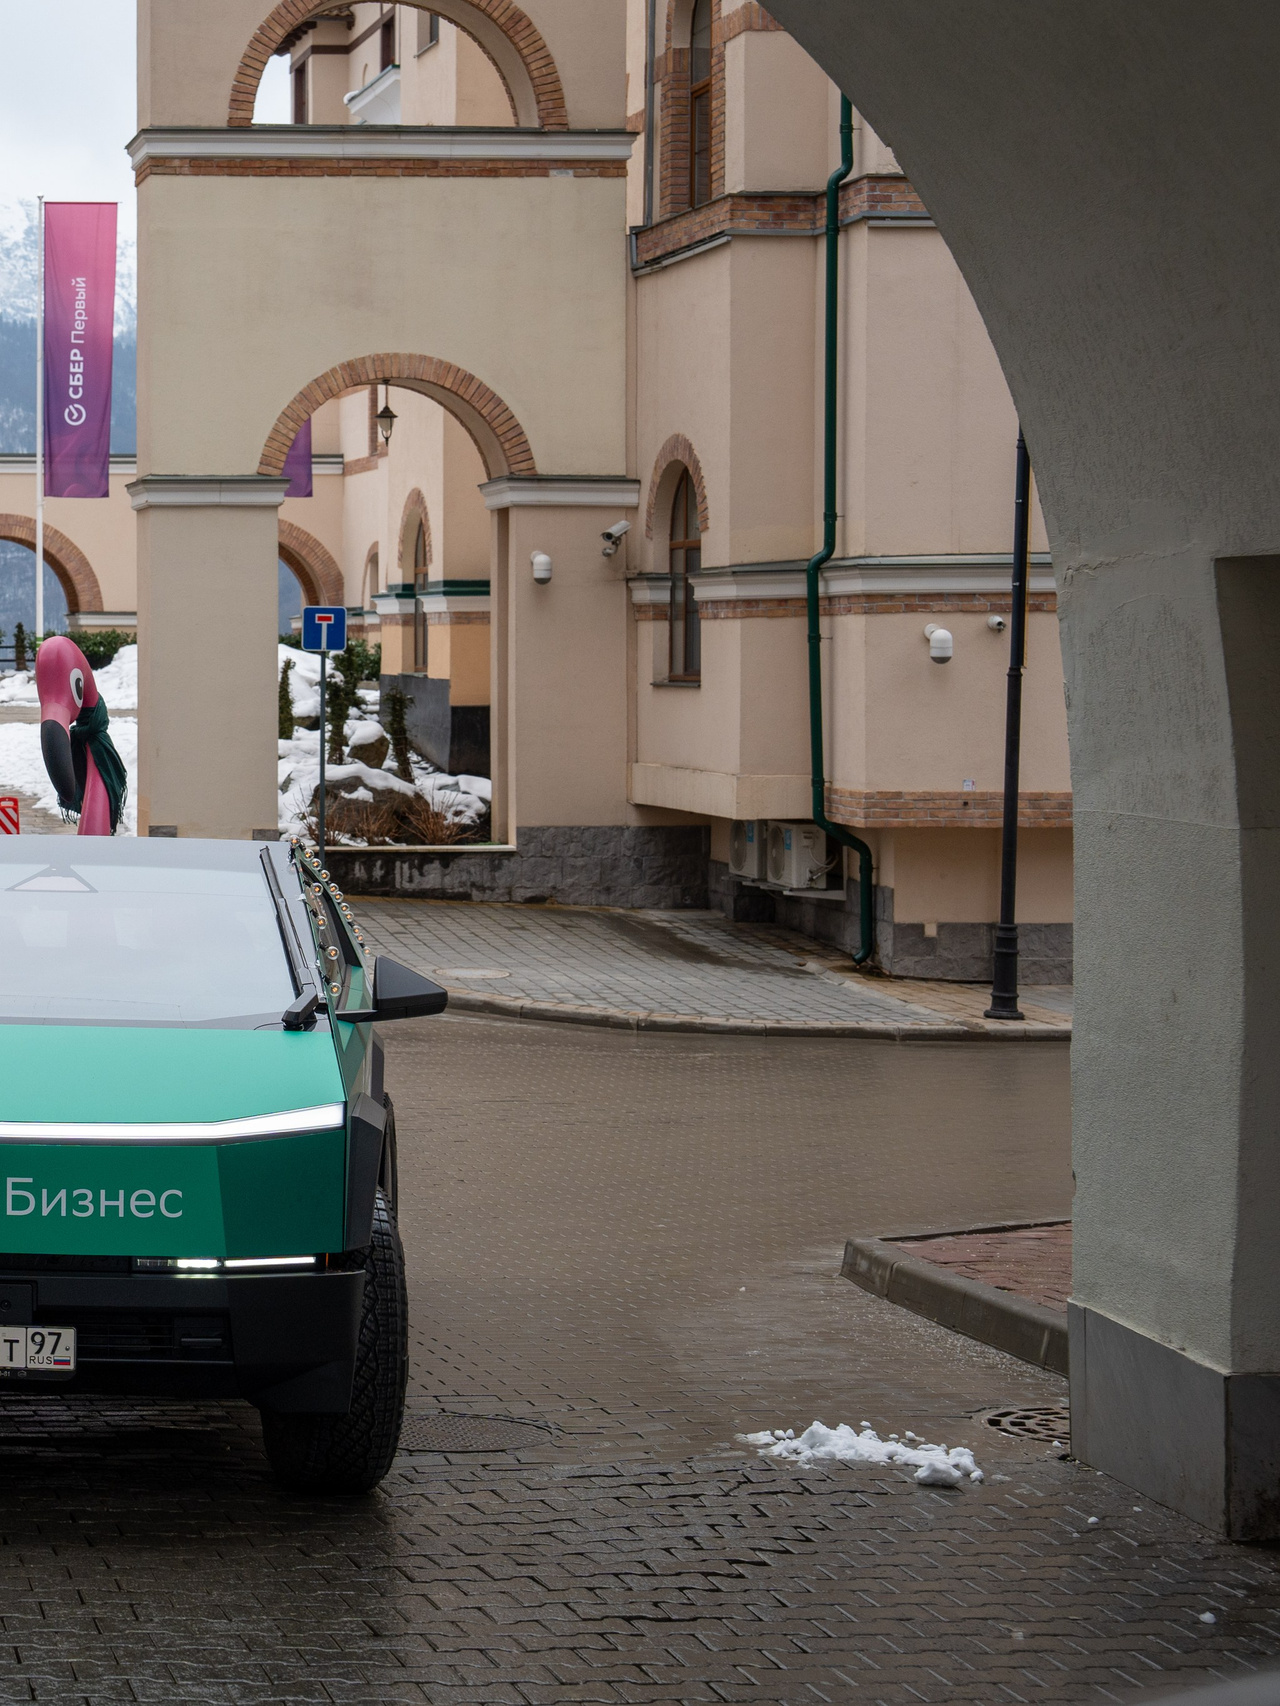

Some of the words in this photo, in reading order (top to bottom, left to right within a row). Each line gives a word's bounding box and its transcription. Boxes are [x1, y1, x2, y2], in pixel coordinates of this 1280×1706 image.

[71, 277, 88, 344] Первый
[69, 348, 84, 399] СБЕР
[7, 1177, 183, 1218] Бизнес
[29, 1355, 53, 1365] RUS
[30, 1331, 62, 1355] 97
